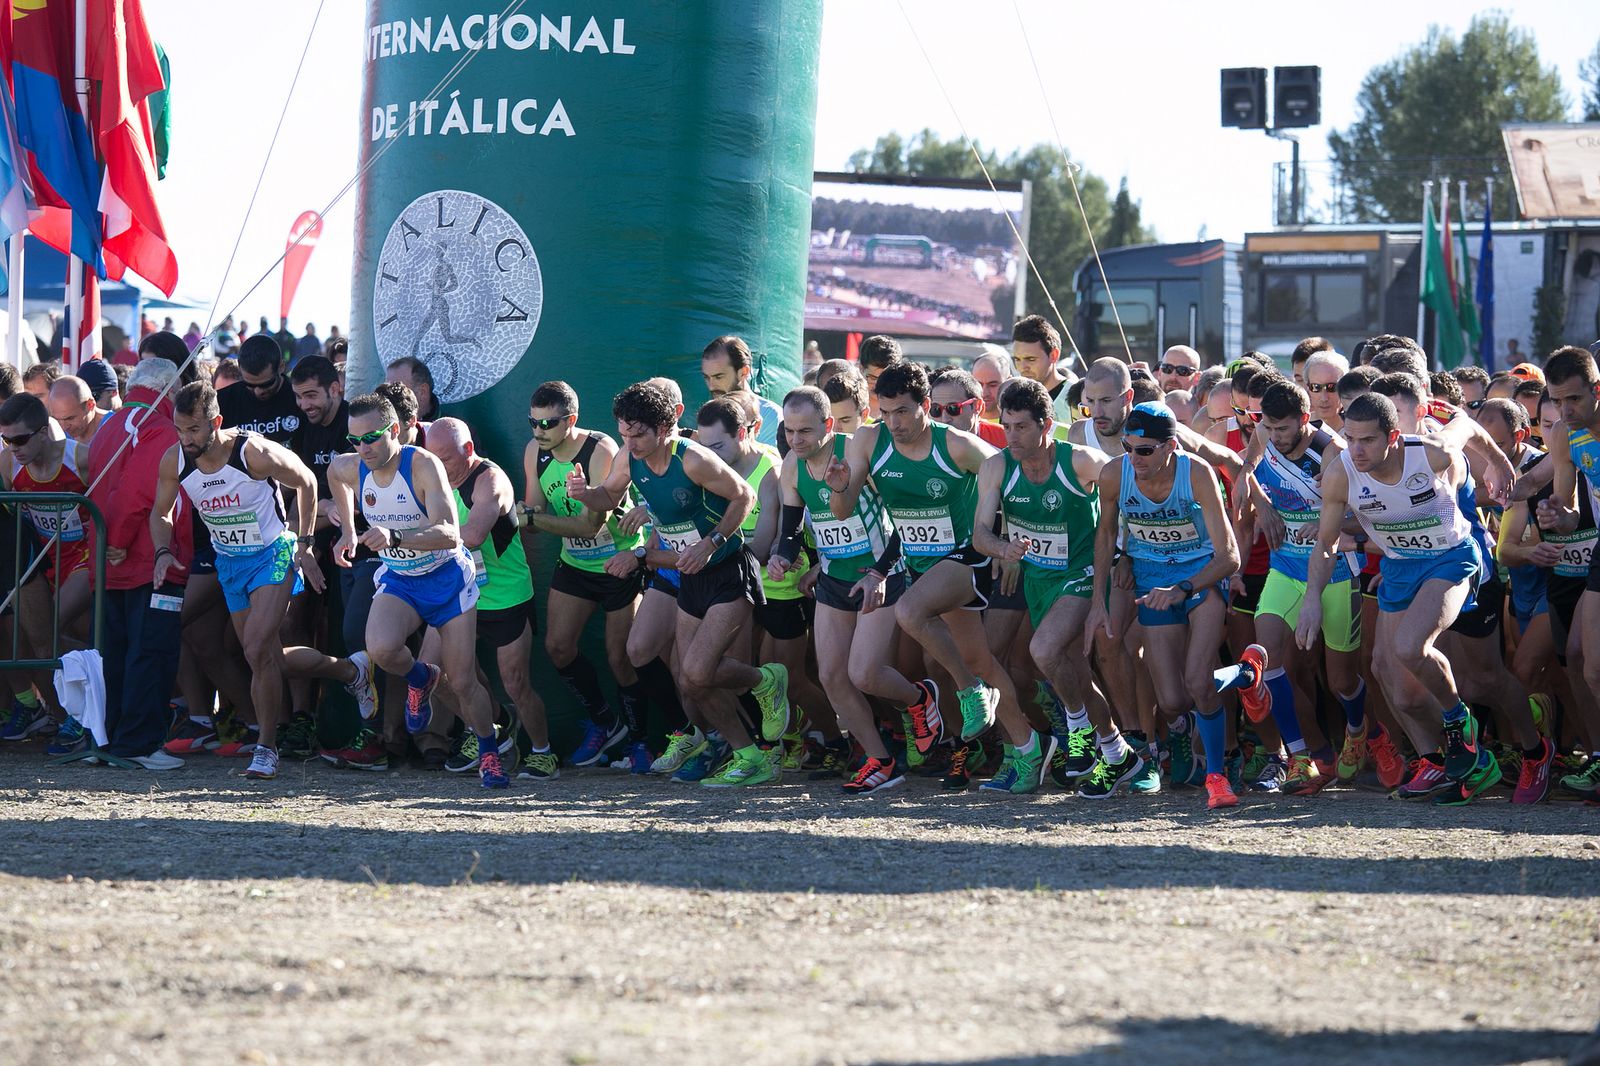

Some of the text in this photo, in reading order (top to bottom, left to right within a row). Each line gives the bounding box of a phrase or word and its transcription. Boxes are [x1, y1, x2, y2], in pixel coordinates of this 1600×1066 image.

[366, 14, 636, 63] TERNACIONAL
[371, 89, 576, 142] DE ITÁLICA
[927, 508, 947, 517] SEVILLA
[1127, 506, 1180, 520] nerja
[1417, 518, 1439, 528] SEVILLA
[212, 529, 247, 544] 1547
[818, 525, 853, 546] 1679
[898, 525, 940, 543] 1392
[1136, 529, 1182, 543] 1439
[1386, 535, 1433, 549] 1543
[1559, 547, 1592, 565] 493
